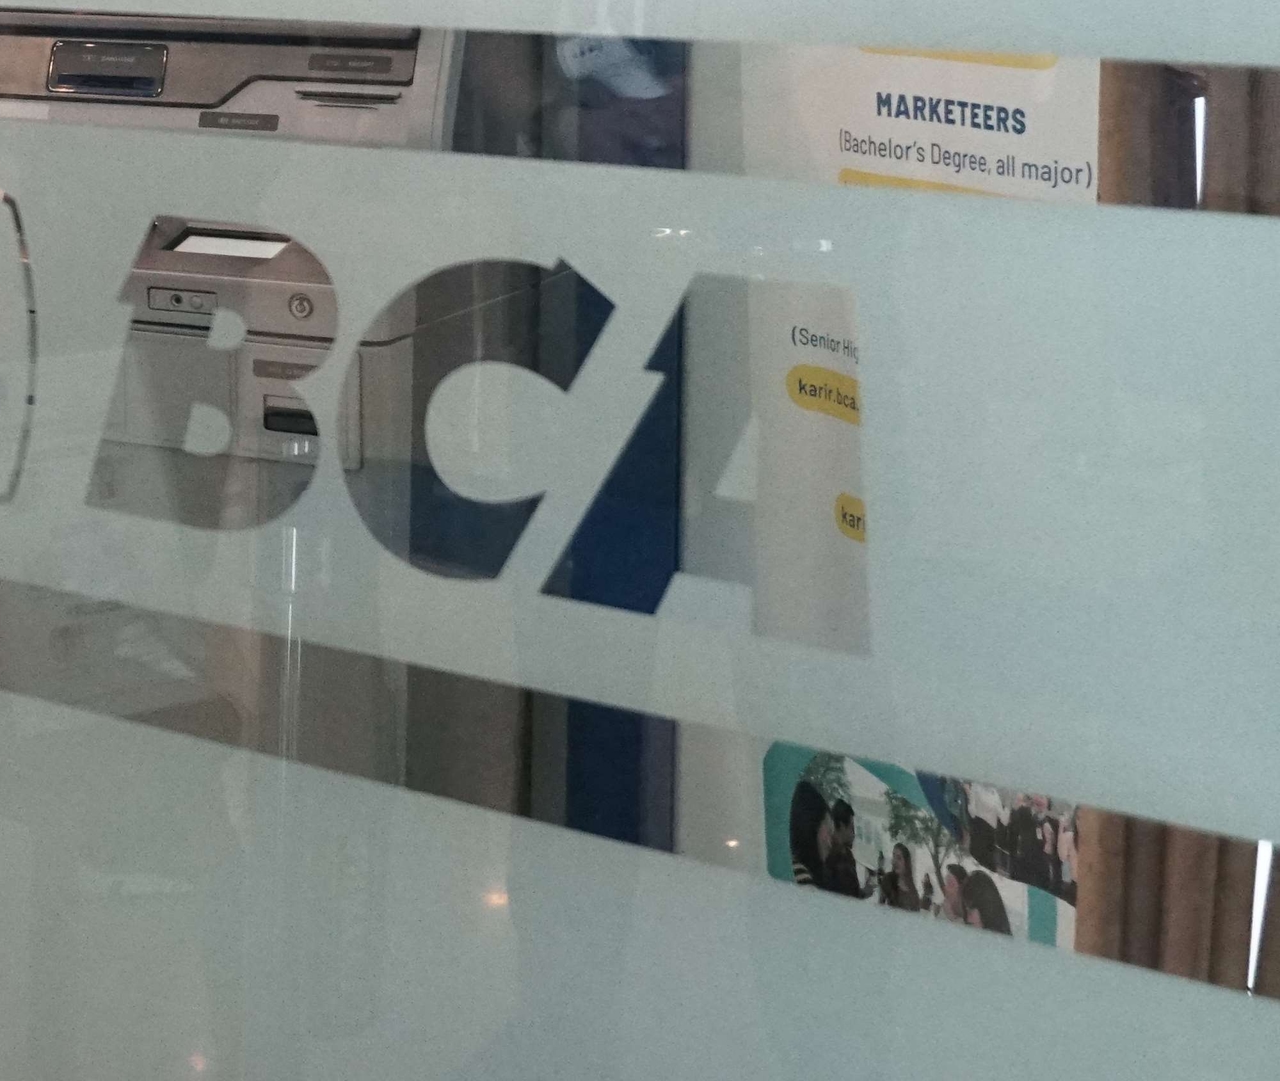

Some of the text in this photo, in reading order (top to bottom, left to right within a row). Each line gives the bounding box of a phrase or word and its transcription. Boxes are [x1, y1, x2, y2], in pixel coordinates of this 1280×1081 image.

[875, 91, 1028, 136] MARKETEERS
[930, 142, 992, 176] Degree,
[996, 154, 1016, 178] all
[1021, 159, 1094, 189] major)
[791, 325, 841, 354] (Senior
[84, 214, 873, 657] BCA
